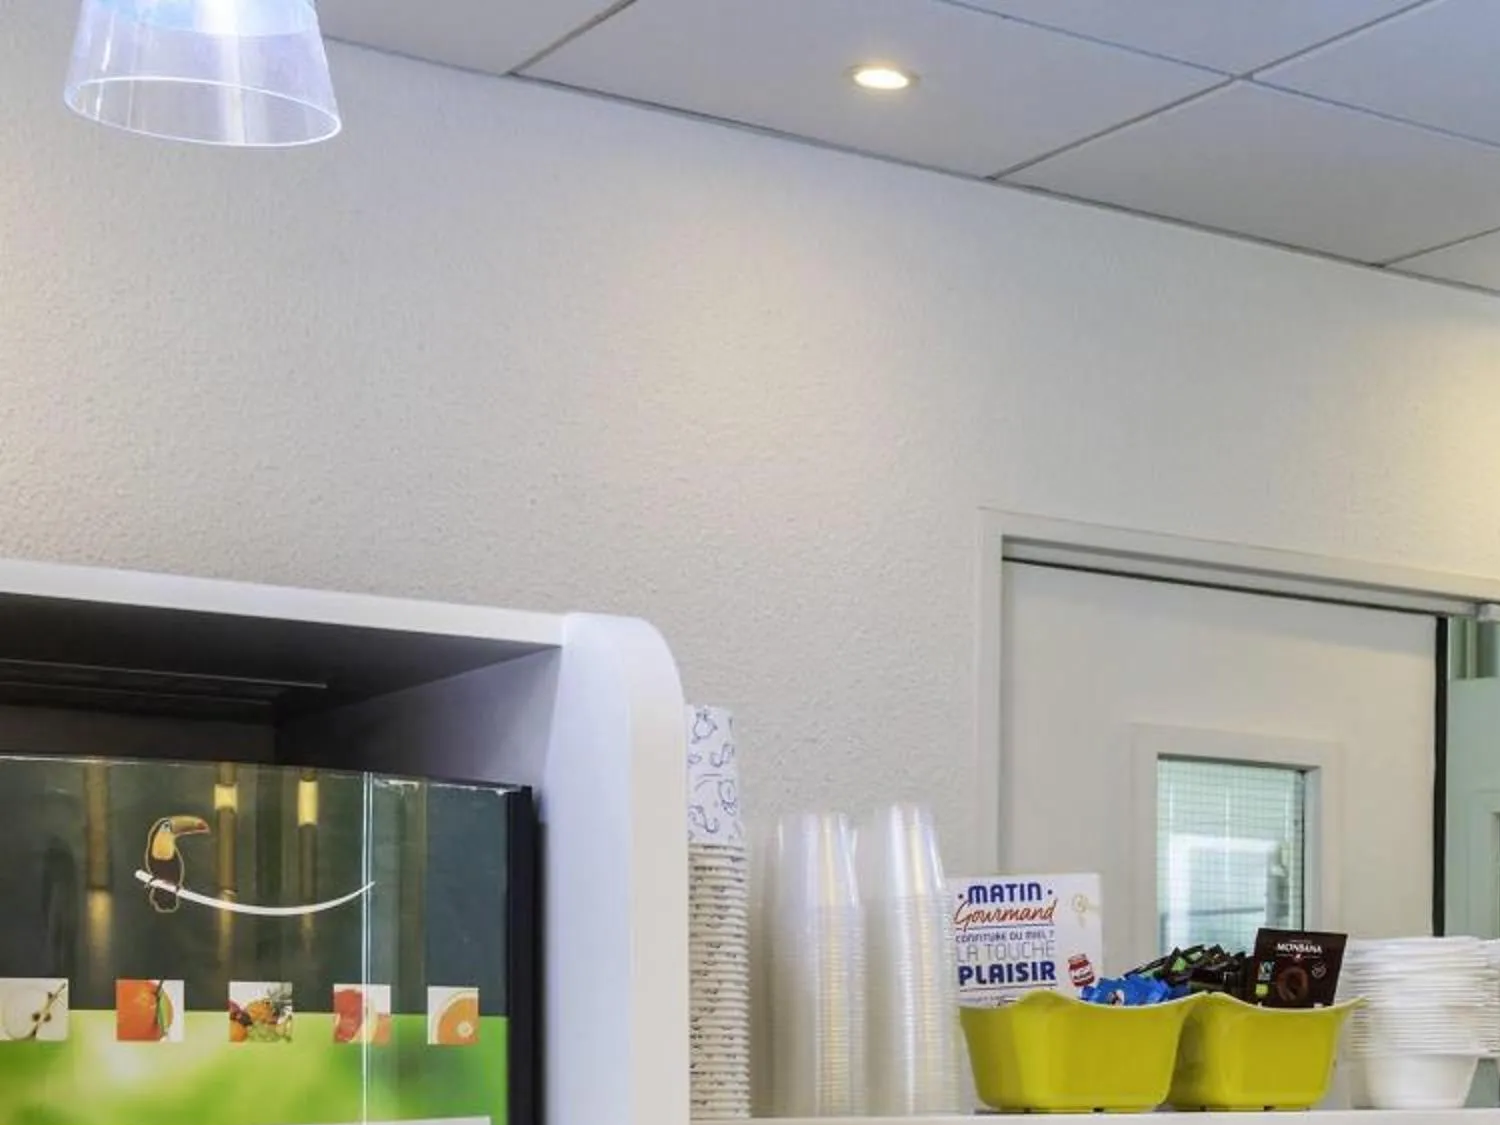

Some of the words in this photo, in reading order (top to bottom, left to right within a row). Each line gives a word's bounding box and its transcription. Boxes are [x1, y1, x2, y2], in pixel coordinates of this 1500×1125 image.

[968, 882, 1042, 904] MATIN
[954, 897, 1058, 932] Gourmand
[957, 944, 978, 963] LA
[984, 940, 1055, 961] TOUCHE
[958, 961, 1056, 986] PLAISIR
